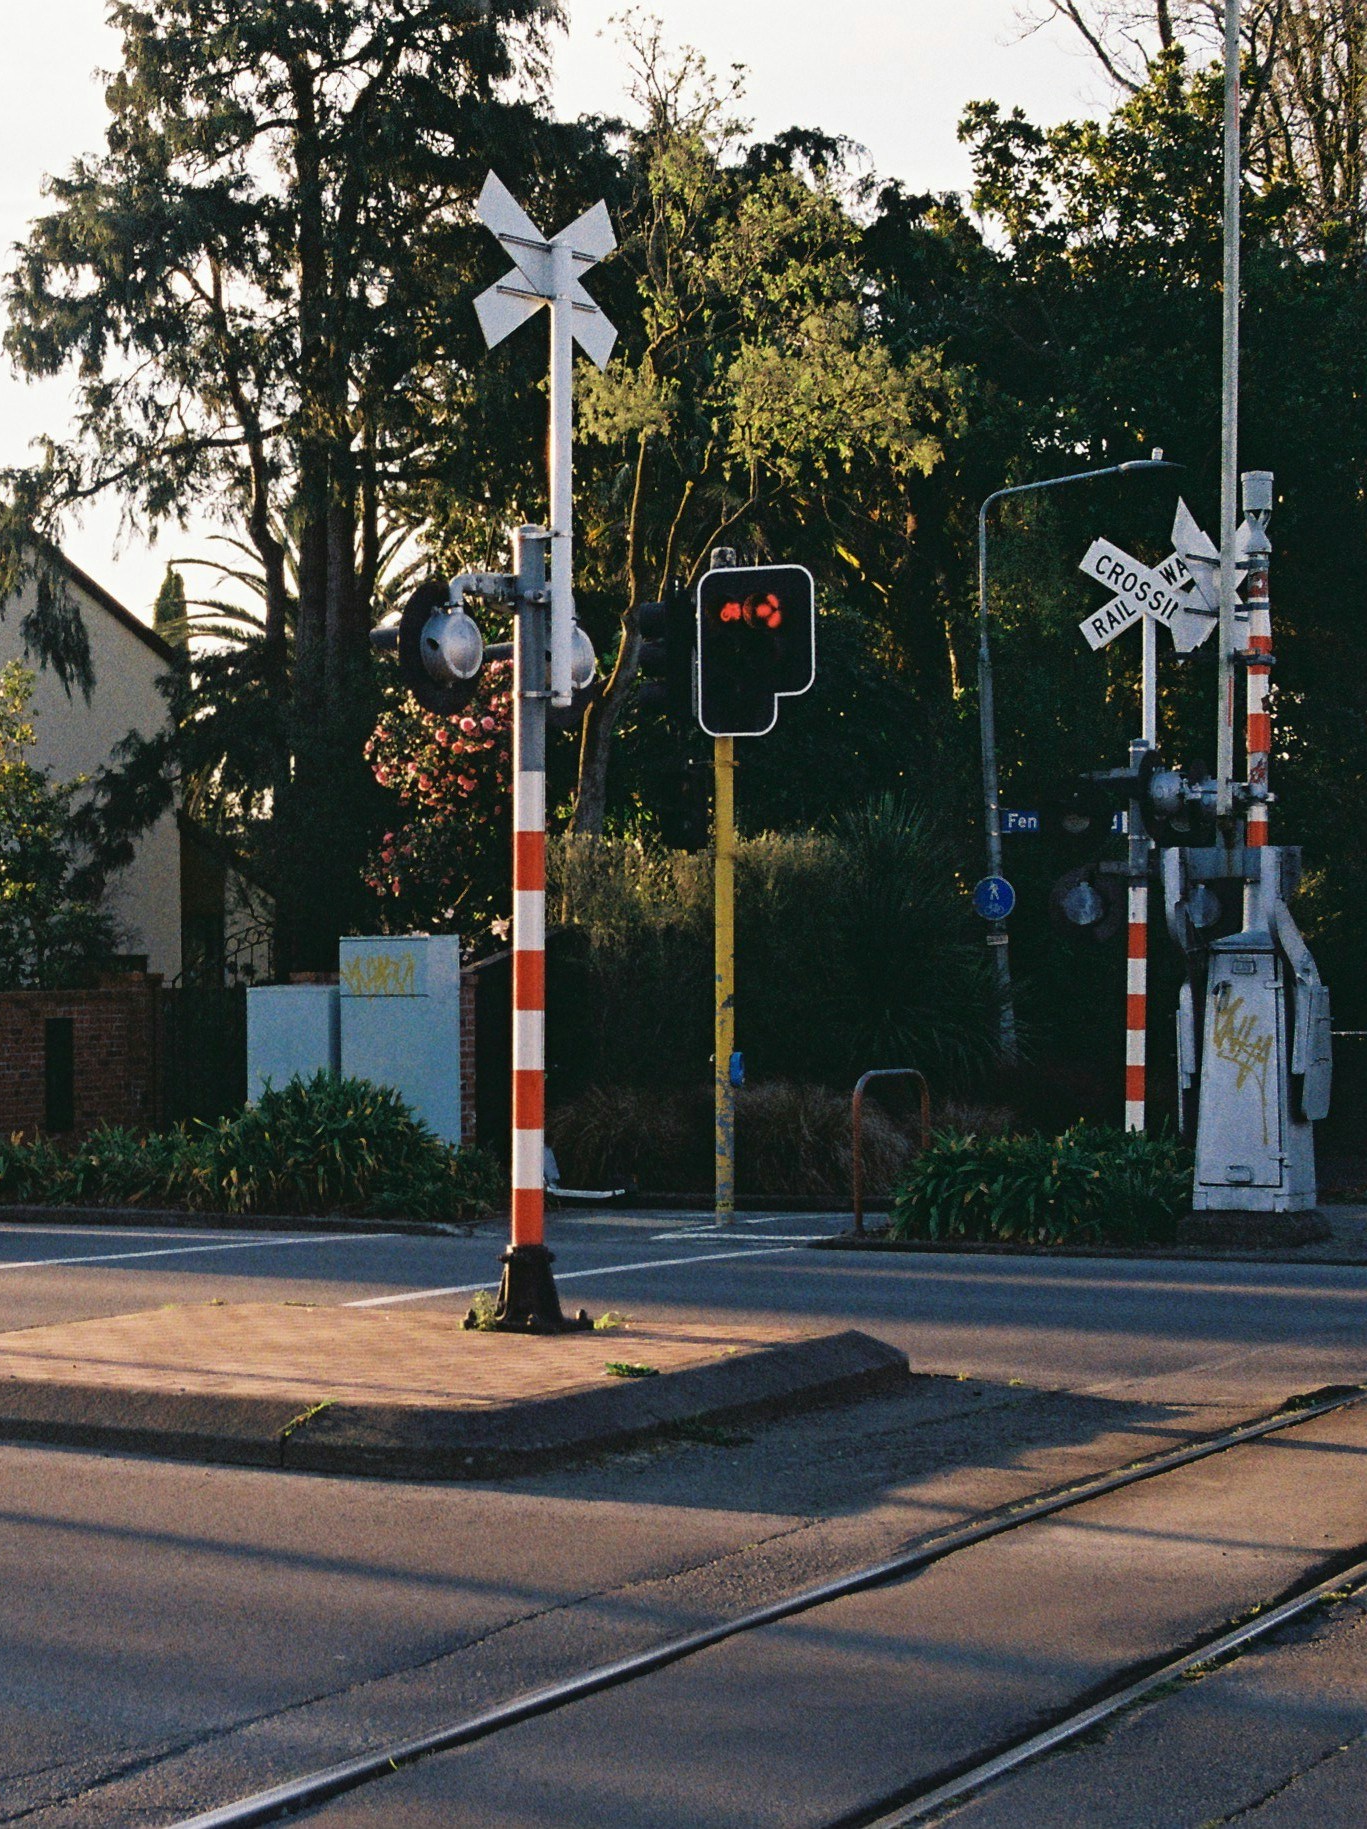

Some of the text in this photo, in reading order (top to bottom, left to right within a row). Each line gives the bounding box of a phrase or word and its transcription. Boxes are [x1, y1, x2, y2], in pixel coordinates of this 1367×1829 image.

[1092, 557, 1190, 639] RAIL WA
[1095, 555, 1179, 620] CROSSI
[1008, 813, 1038, 830] Fen
